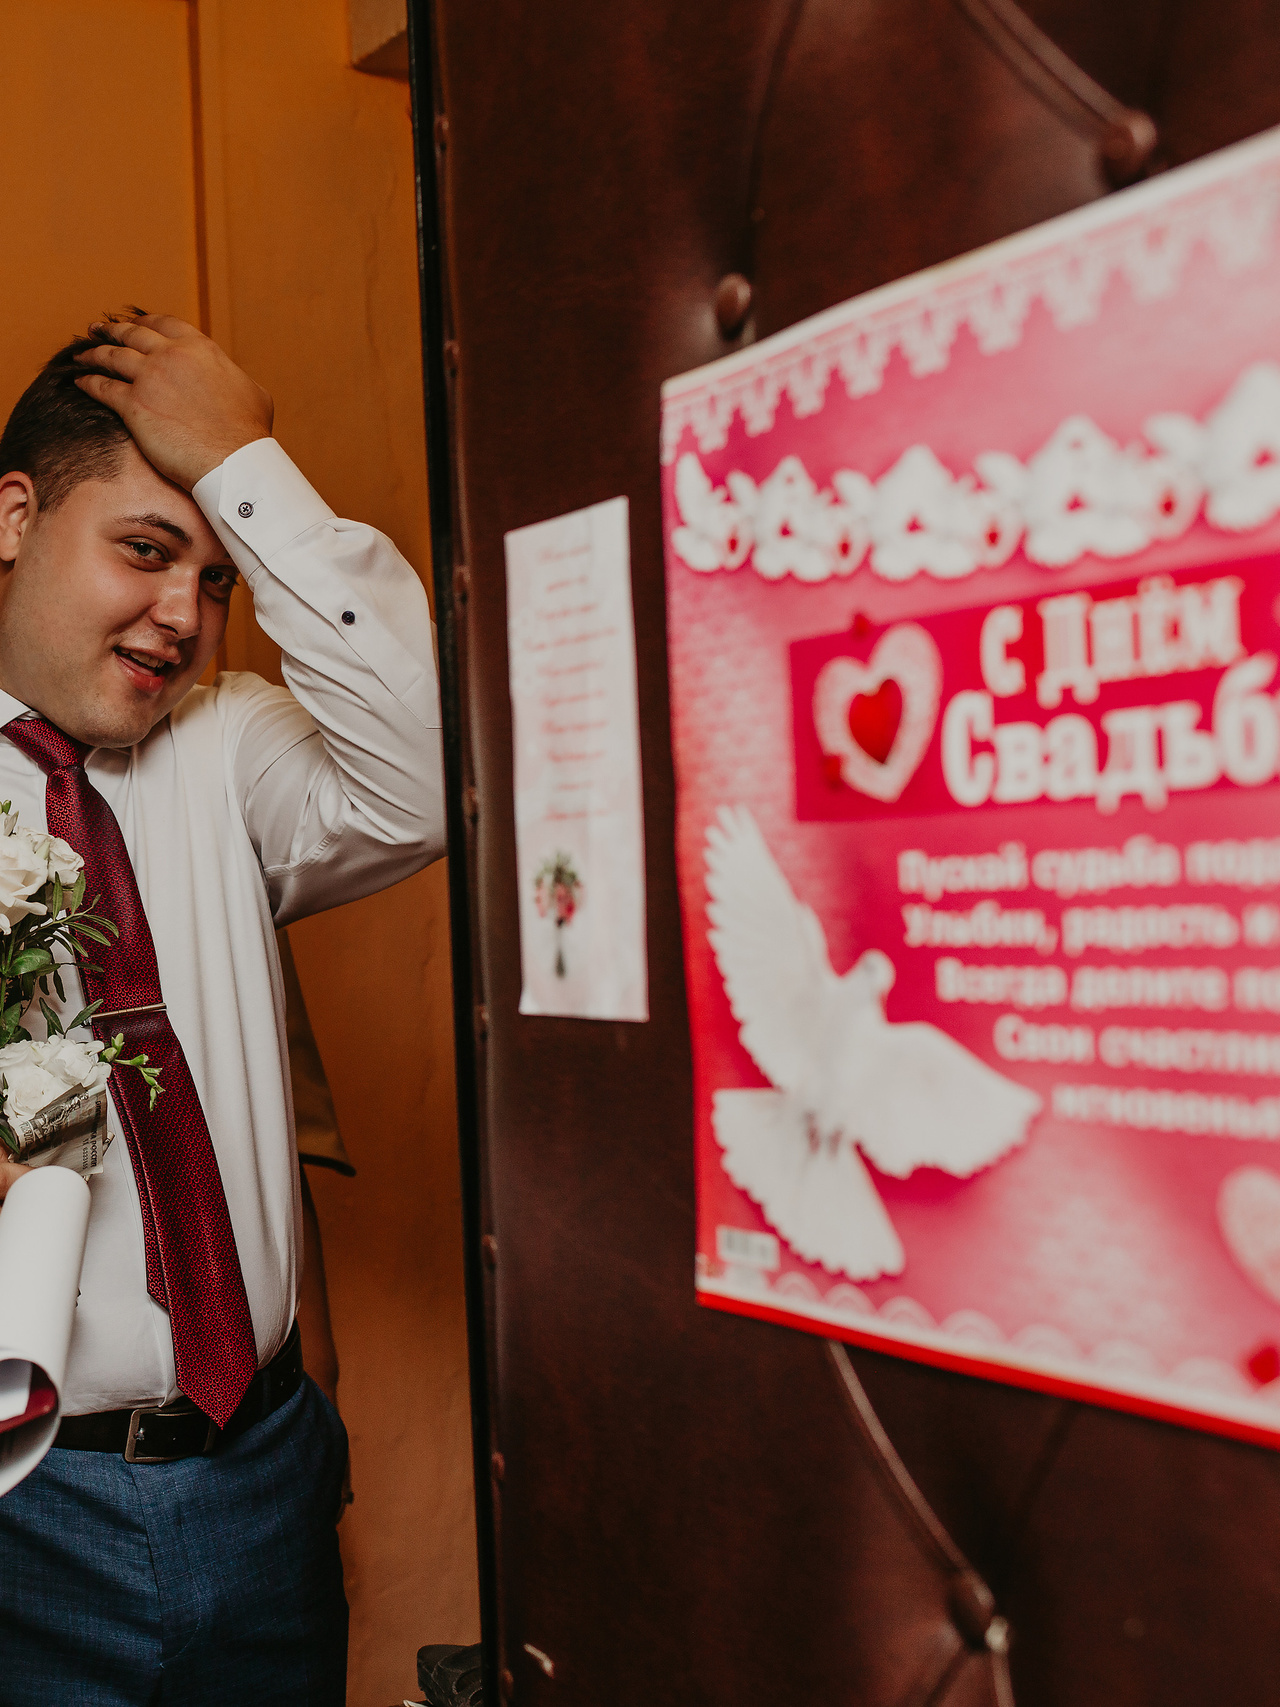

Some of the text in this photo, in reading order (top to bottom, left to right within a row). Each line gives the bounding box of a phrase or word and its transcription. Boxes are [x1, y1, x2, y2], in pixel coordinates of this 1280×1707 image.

[941, 654, 1280, 813] Свадьб
[899, 841, 1029, 899] Пускай
[1032, 833, 1181, 898] судьба
[903, 899, 1059, 955] Улыбки,
[1061, 902, 1241, 957] радость
[935, 956, 1068, 1010] Всегда
[993, 1013, 1096, 1065] Свои
